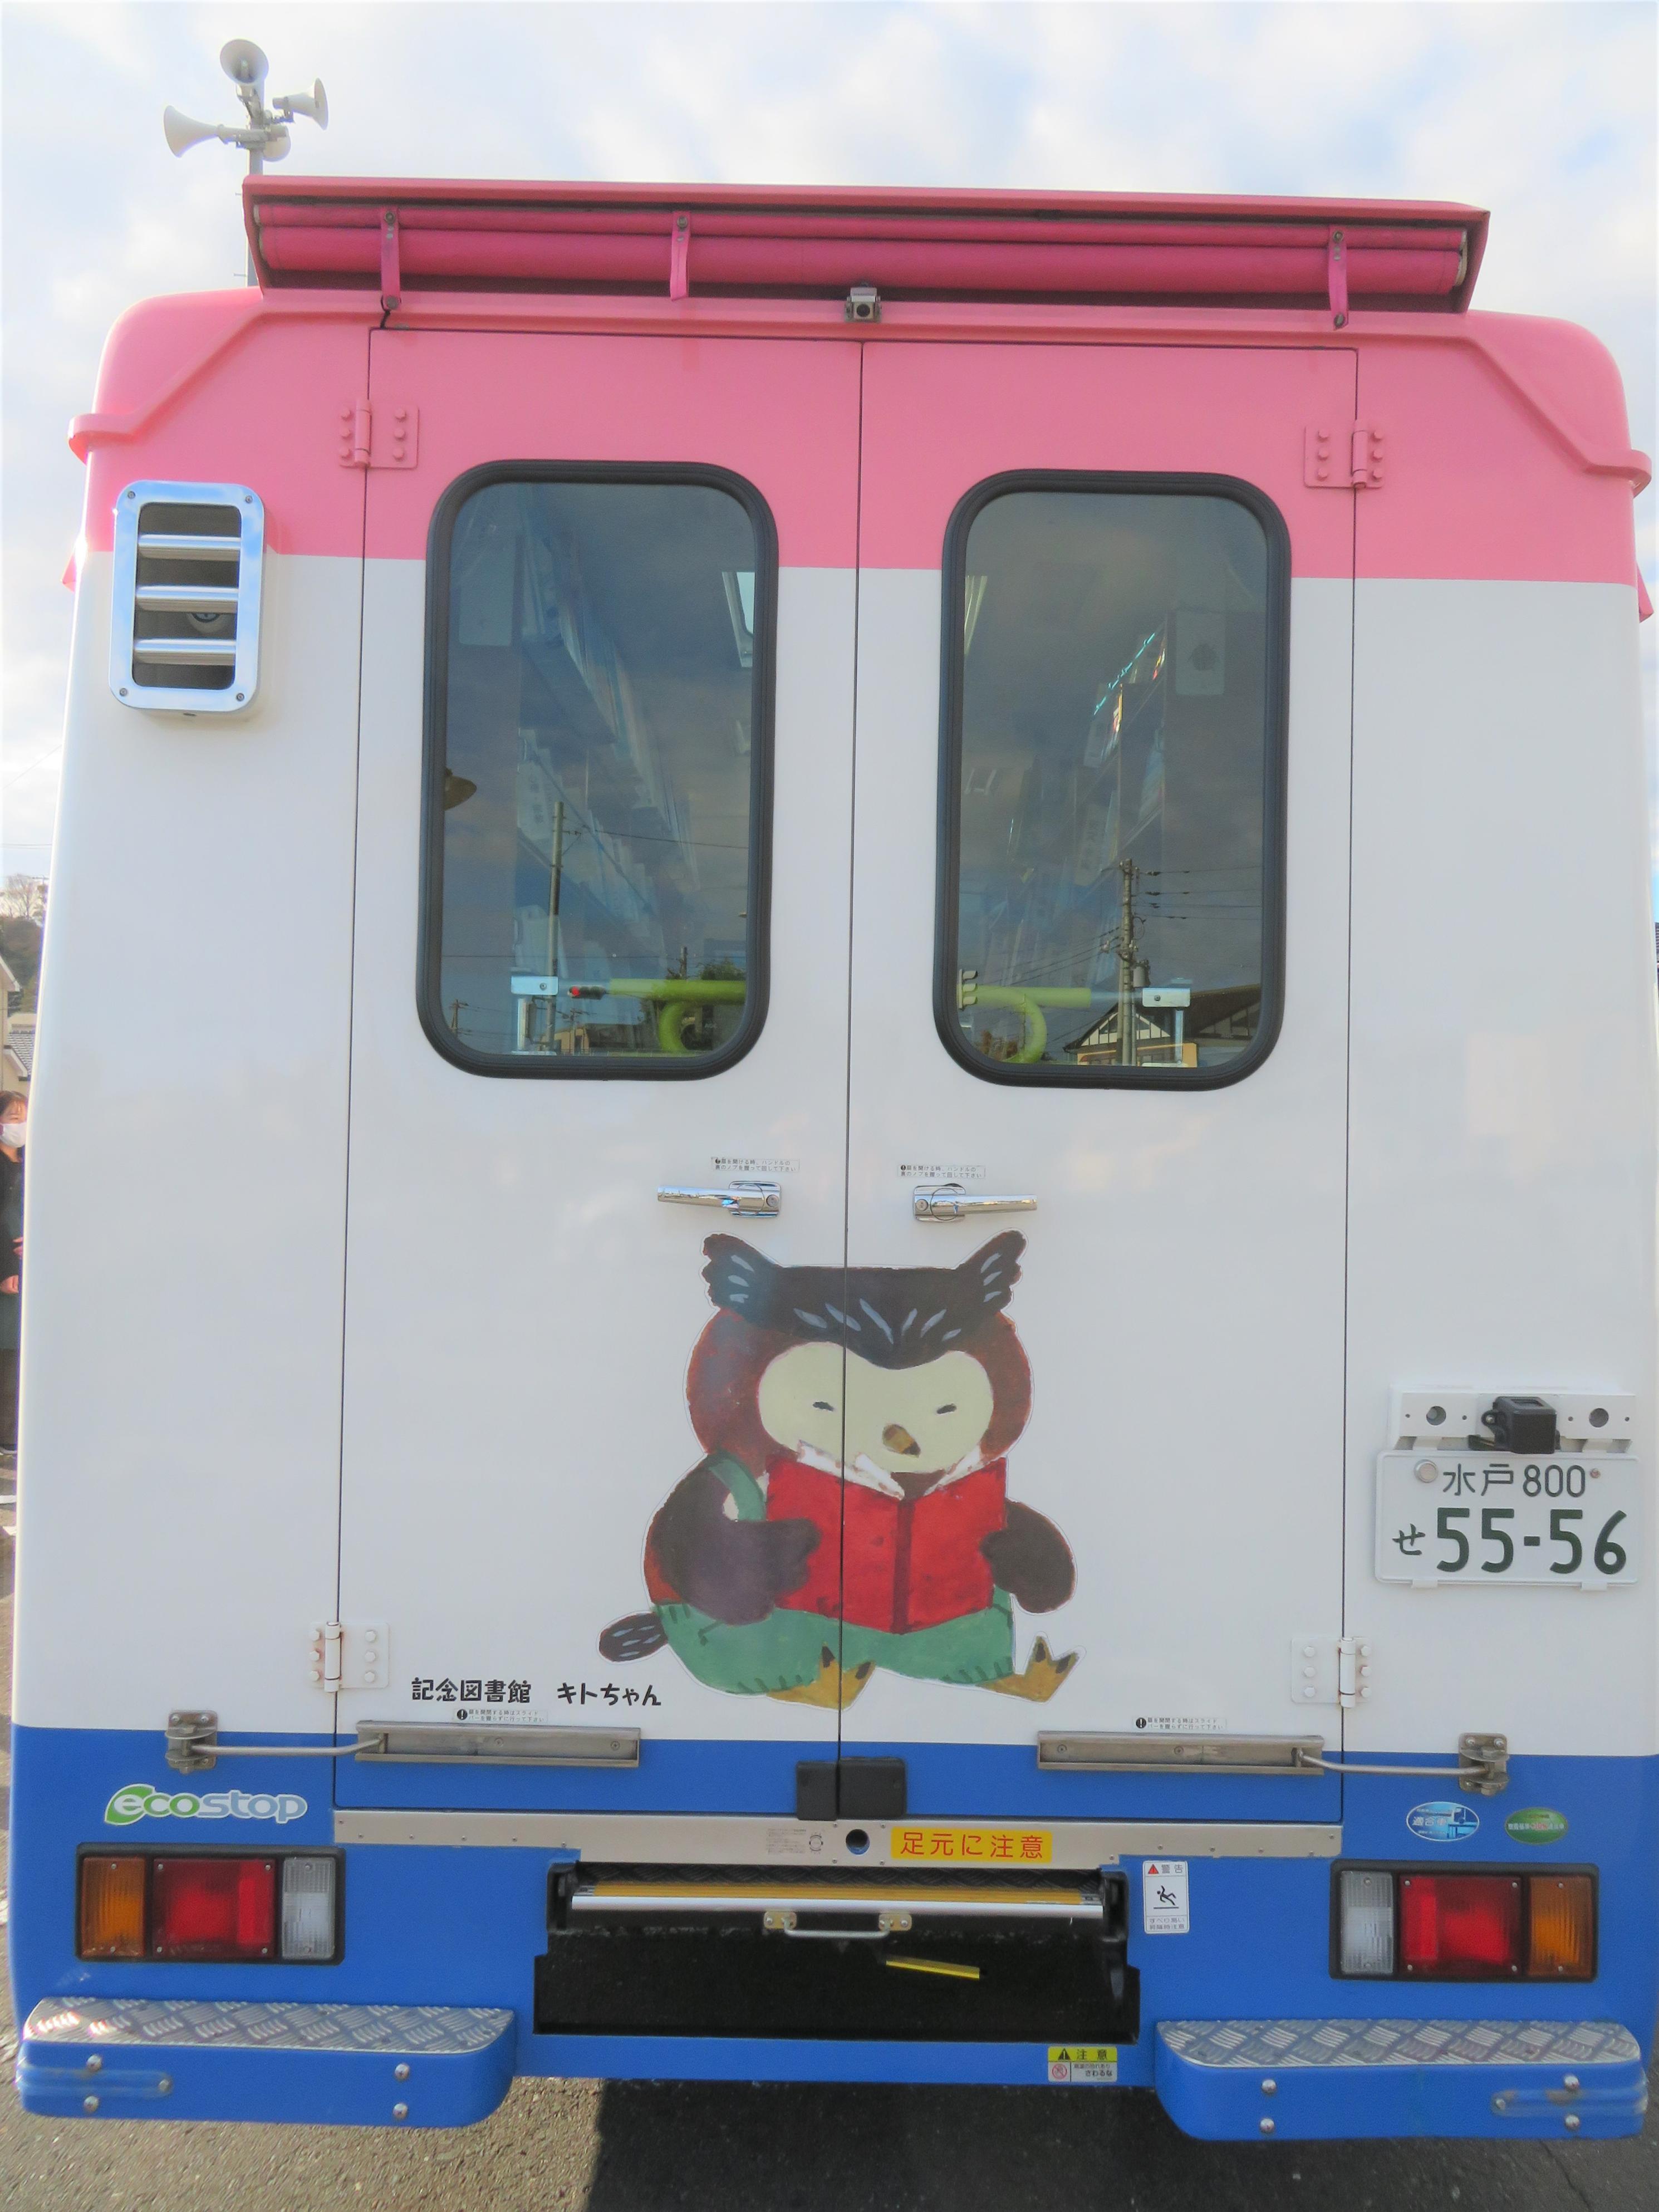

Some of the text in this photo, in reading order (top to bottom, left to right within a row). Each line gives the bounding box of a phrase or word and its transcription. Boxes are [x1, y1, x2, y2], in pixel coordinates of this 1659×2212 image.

[1442, 1463, 1586, 1498] 水戸 800
[1392, 1507, 1627, 1575] せ 55-56
[411, 1676, 662, 1706] 記念図書館 キトちゃん
[111, 1788, 307, 1823] ecostop
[900, 1832, 1044, 1859] 足元に注意
[1161, 1865, 1184, 1873] 警告
[1077, 2049, 1108, 2060] 注意
